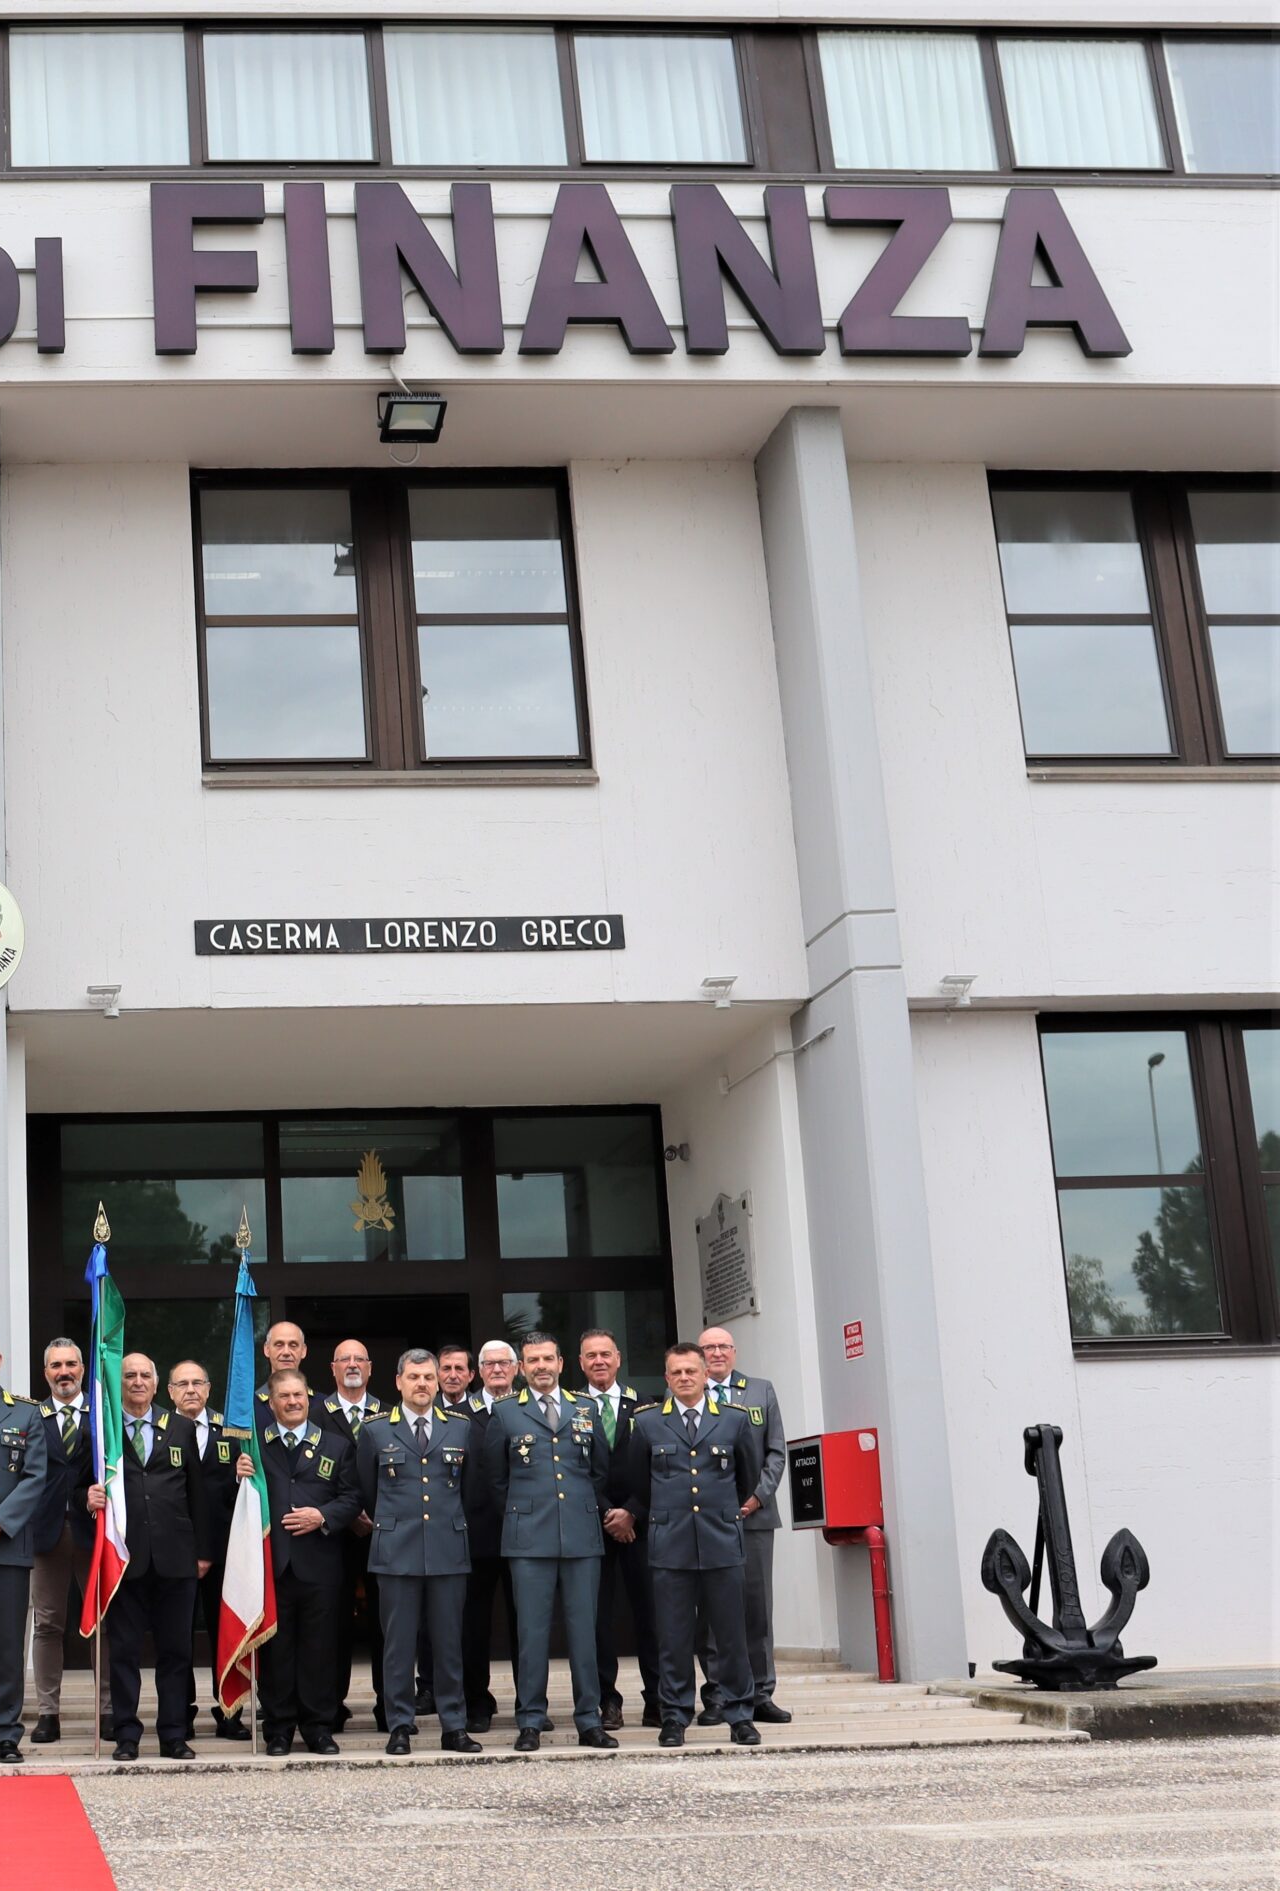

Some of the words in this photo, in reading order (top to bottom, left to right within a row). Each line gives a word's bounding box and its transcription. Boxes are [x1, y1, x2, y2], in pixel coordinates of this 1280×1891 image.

[150, 183, 1132, 359] FINANZA
[209, 922, 341, 950] CASERMA
[365, 920, 497, 949] LORENZO
[521, 919, 612, 947] GRECO
[795, 1456, 816, 1468] ATTACCO
